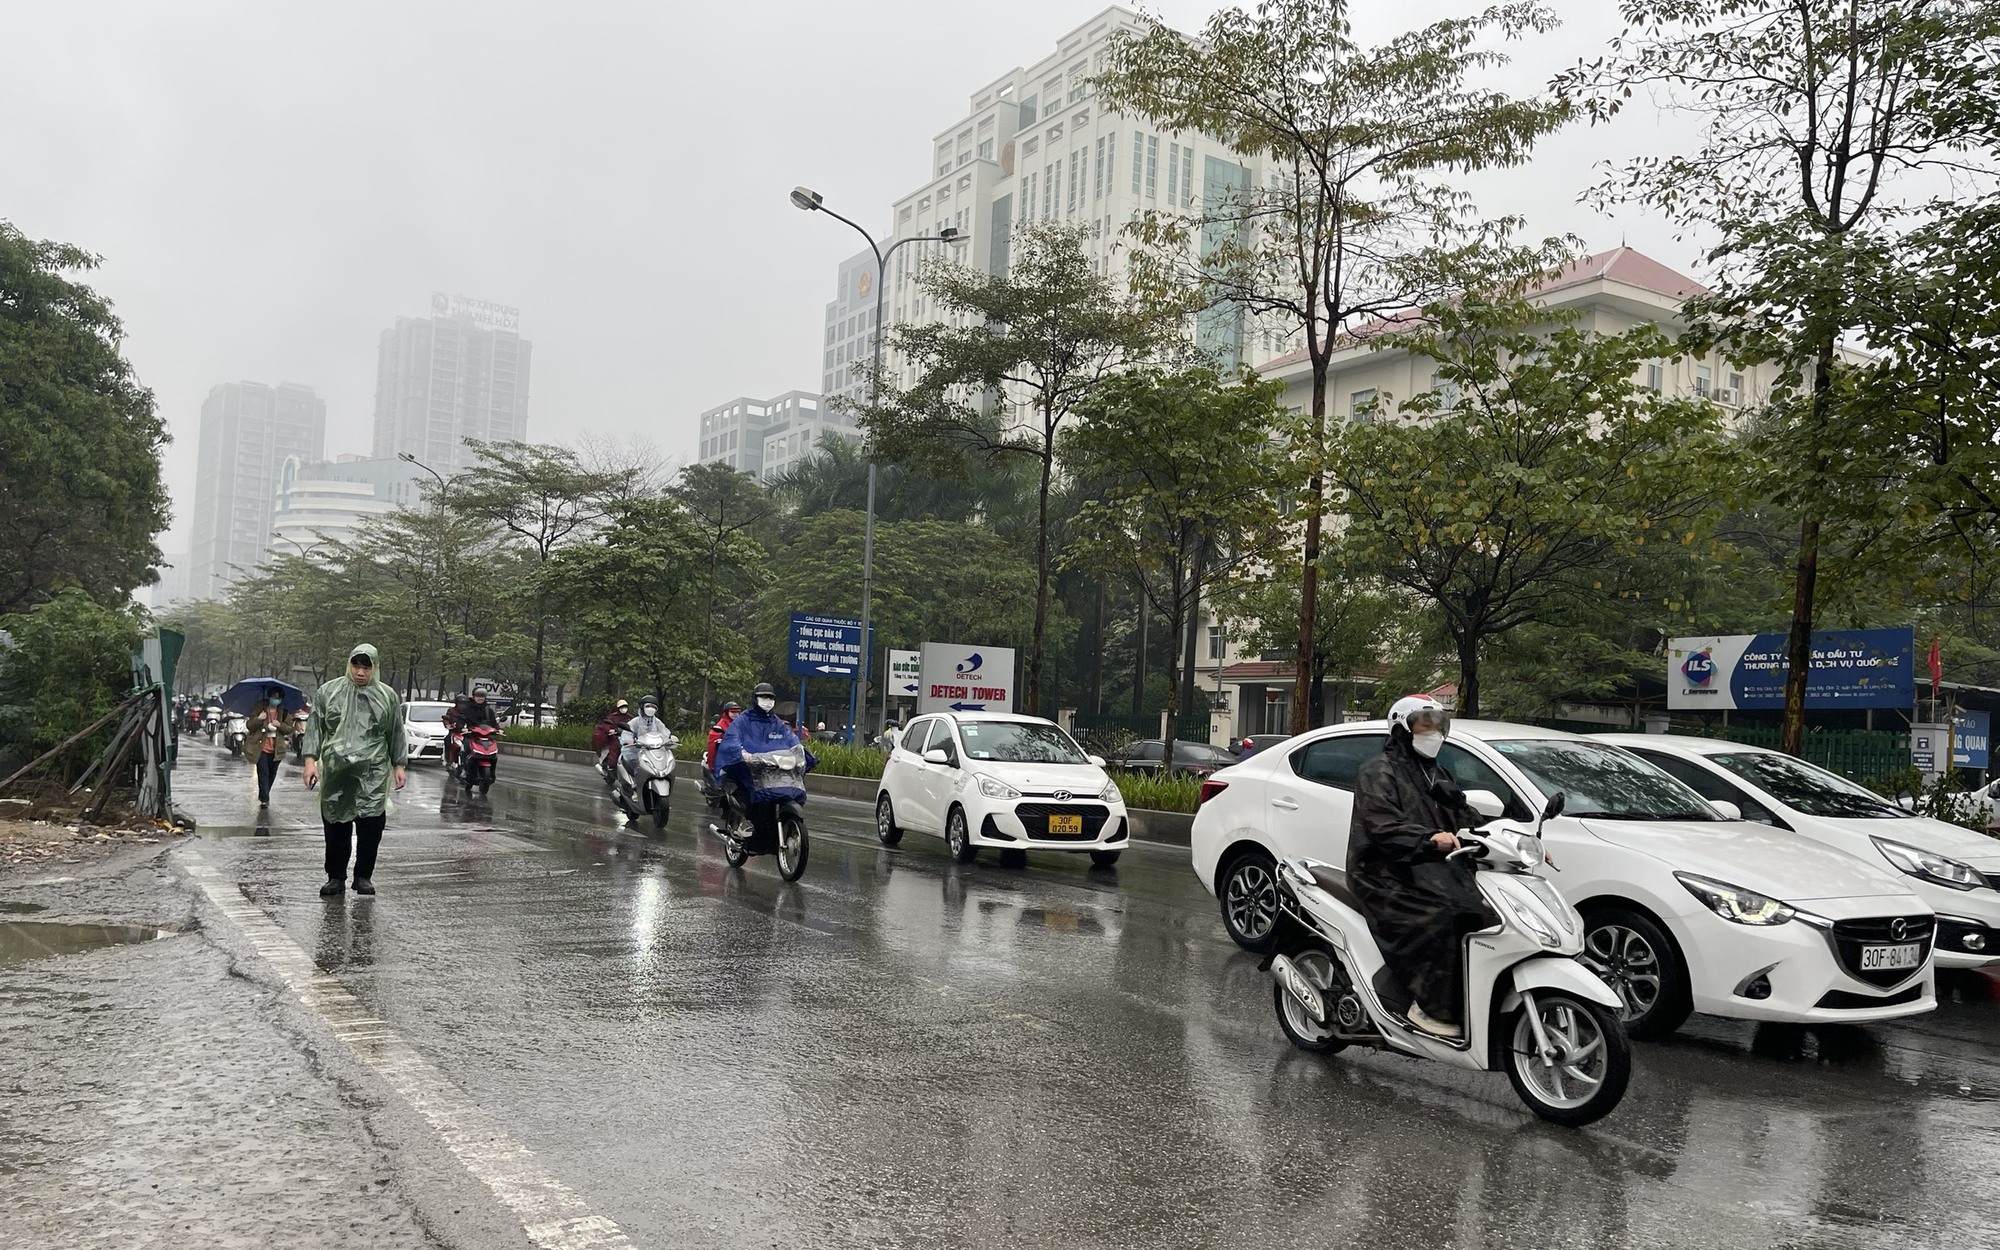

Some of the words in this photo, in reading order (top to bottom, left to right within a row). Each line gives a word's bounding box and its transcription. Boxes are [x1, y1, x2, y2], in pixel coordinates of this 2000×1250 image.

[813, 628, 823, 638] CỤC
[835, 628, 843, 639] SỐ
[798, 639, 809, 650] CỤC
[797, 651, 808, 662] CỤC
[823, 653, 829, 663] LÝ
[1744, 652, 1768, 661] CÔNG
[1849, 650, 1863, 658] TƯ
[1687, 659, 1711, 671] ILS
[1744, 662, 1780, 670] THƯƠNG
[1839, 660, 1854, 669] VỤ
[930, 684, 968, 699] DETECH
[972, 686, 1006, 701] TOWER
[1965, 734, 1987, 752] QUAN
[1059, 816, 1072, 824] 30F
[1474, 939, 1496, 951] HONDA
